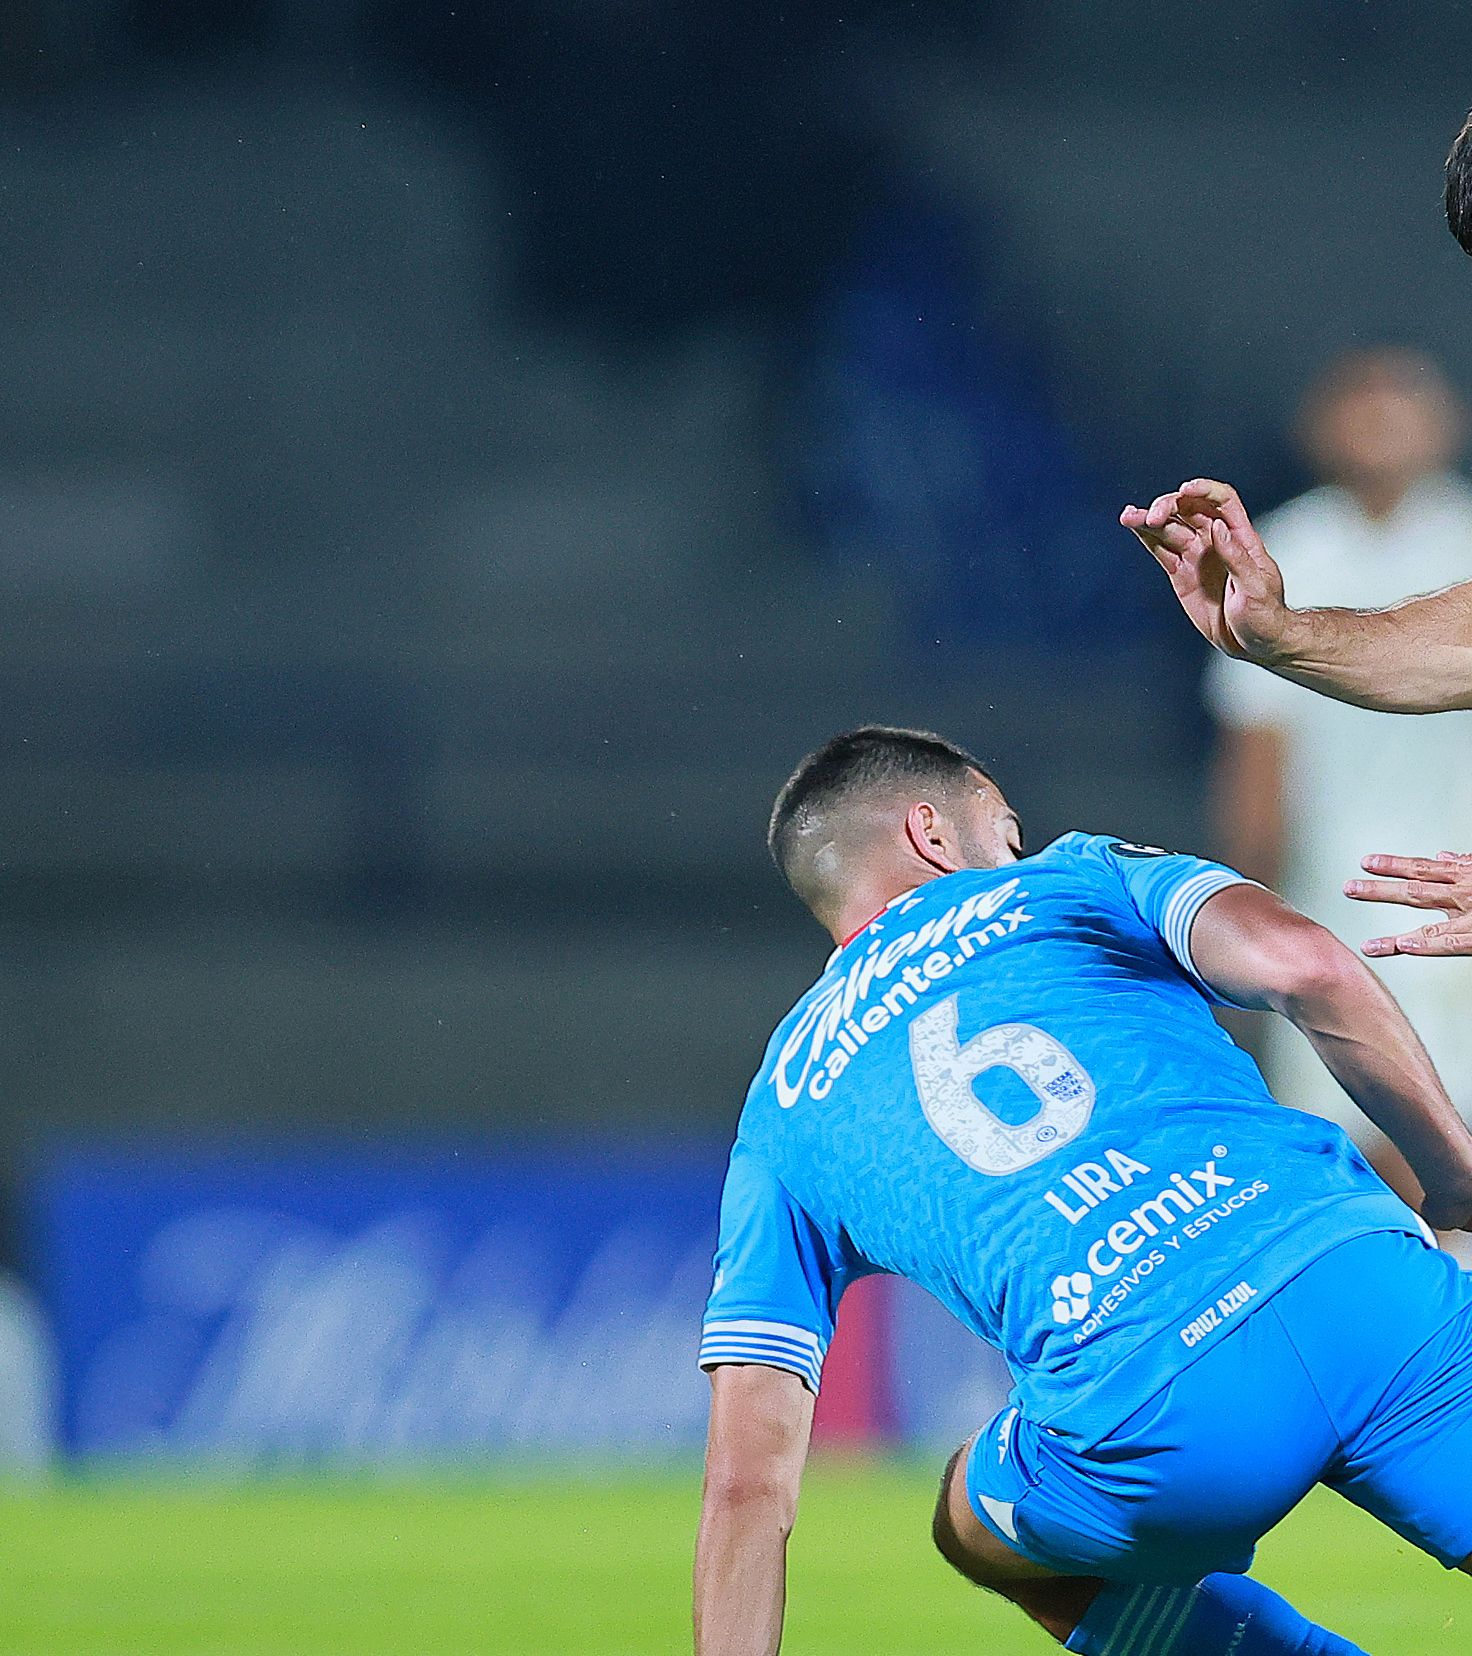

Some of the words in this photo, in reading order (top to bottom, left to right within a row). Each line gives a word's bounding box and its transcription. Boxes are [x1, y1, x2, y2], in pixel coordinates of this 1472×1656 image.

[808, 905, 1035, 1100] caliente.mx
[908, 992, 1096, 1177] 6
[1043, 1148, 1152, 1225] LIRA
[1073, 1249, 1166, 1345] ADHESIVOS
[1163, 1235, 1181, 1250] Y
[1182, 1179, 1270, 1240] ESTUCOS
[1179, 1306, 1223, 1348] CRUZ
[1215, 1280, 1258, 1318] AZUL
